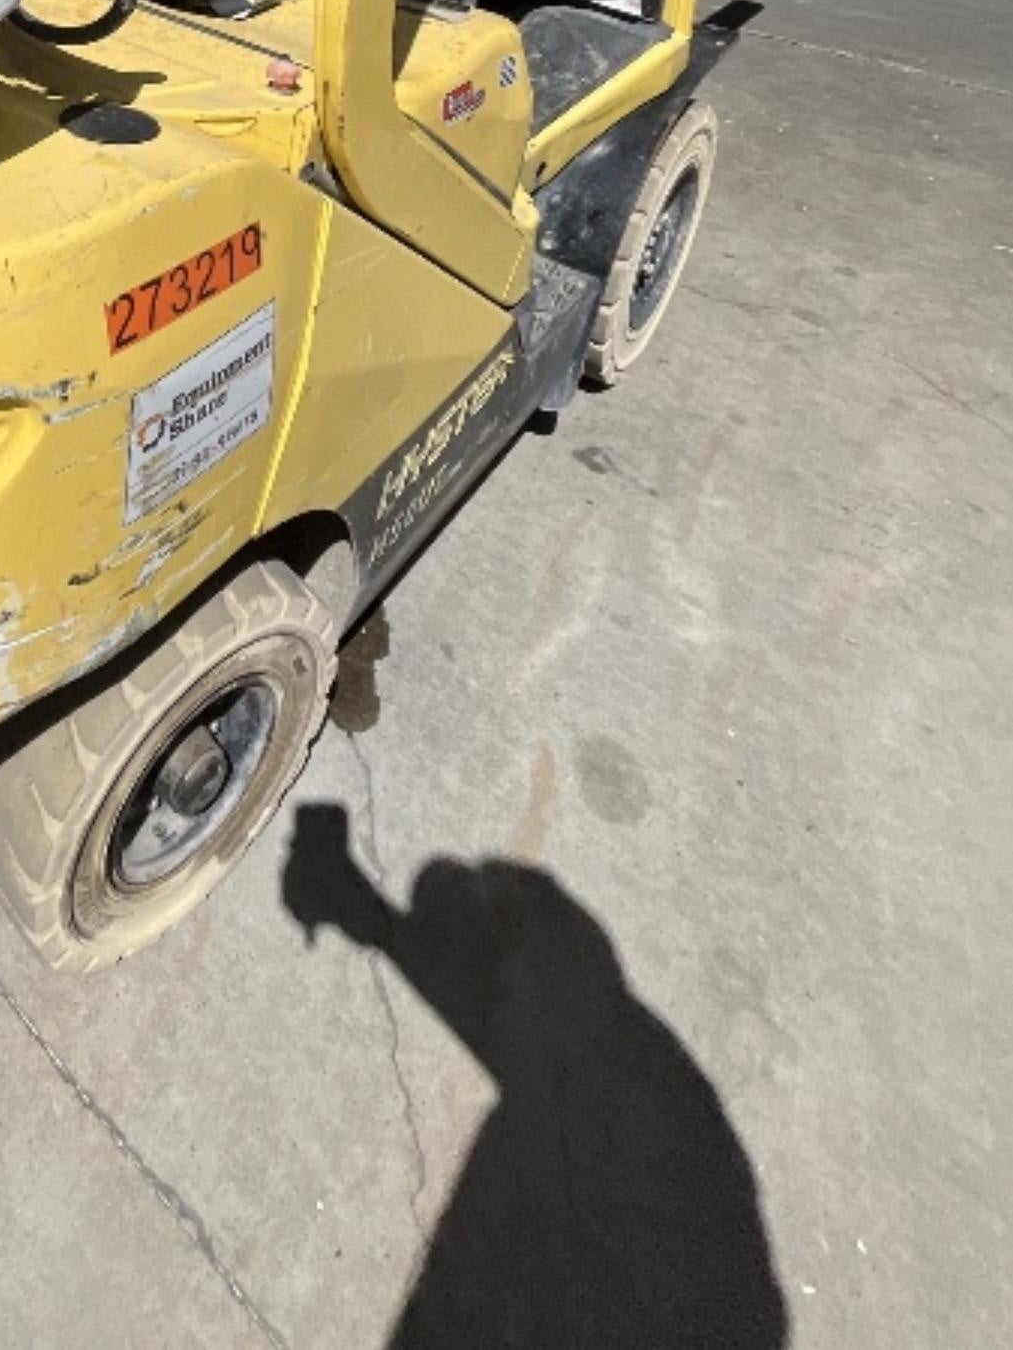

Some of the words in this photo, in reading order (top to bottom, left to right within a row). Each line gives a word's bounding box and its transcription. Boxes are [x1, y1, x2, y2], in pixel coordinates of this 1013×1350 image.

[110, 223, 263, 350] 273219
[171, 332, 273, 412] Equipment
[169, 390, 229, 442] Share
